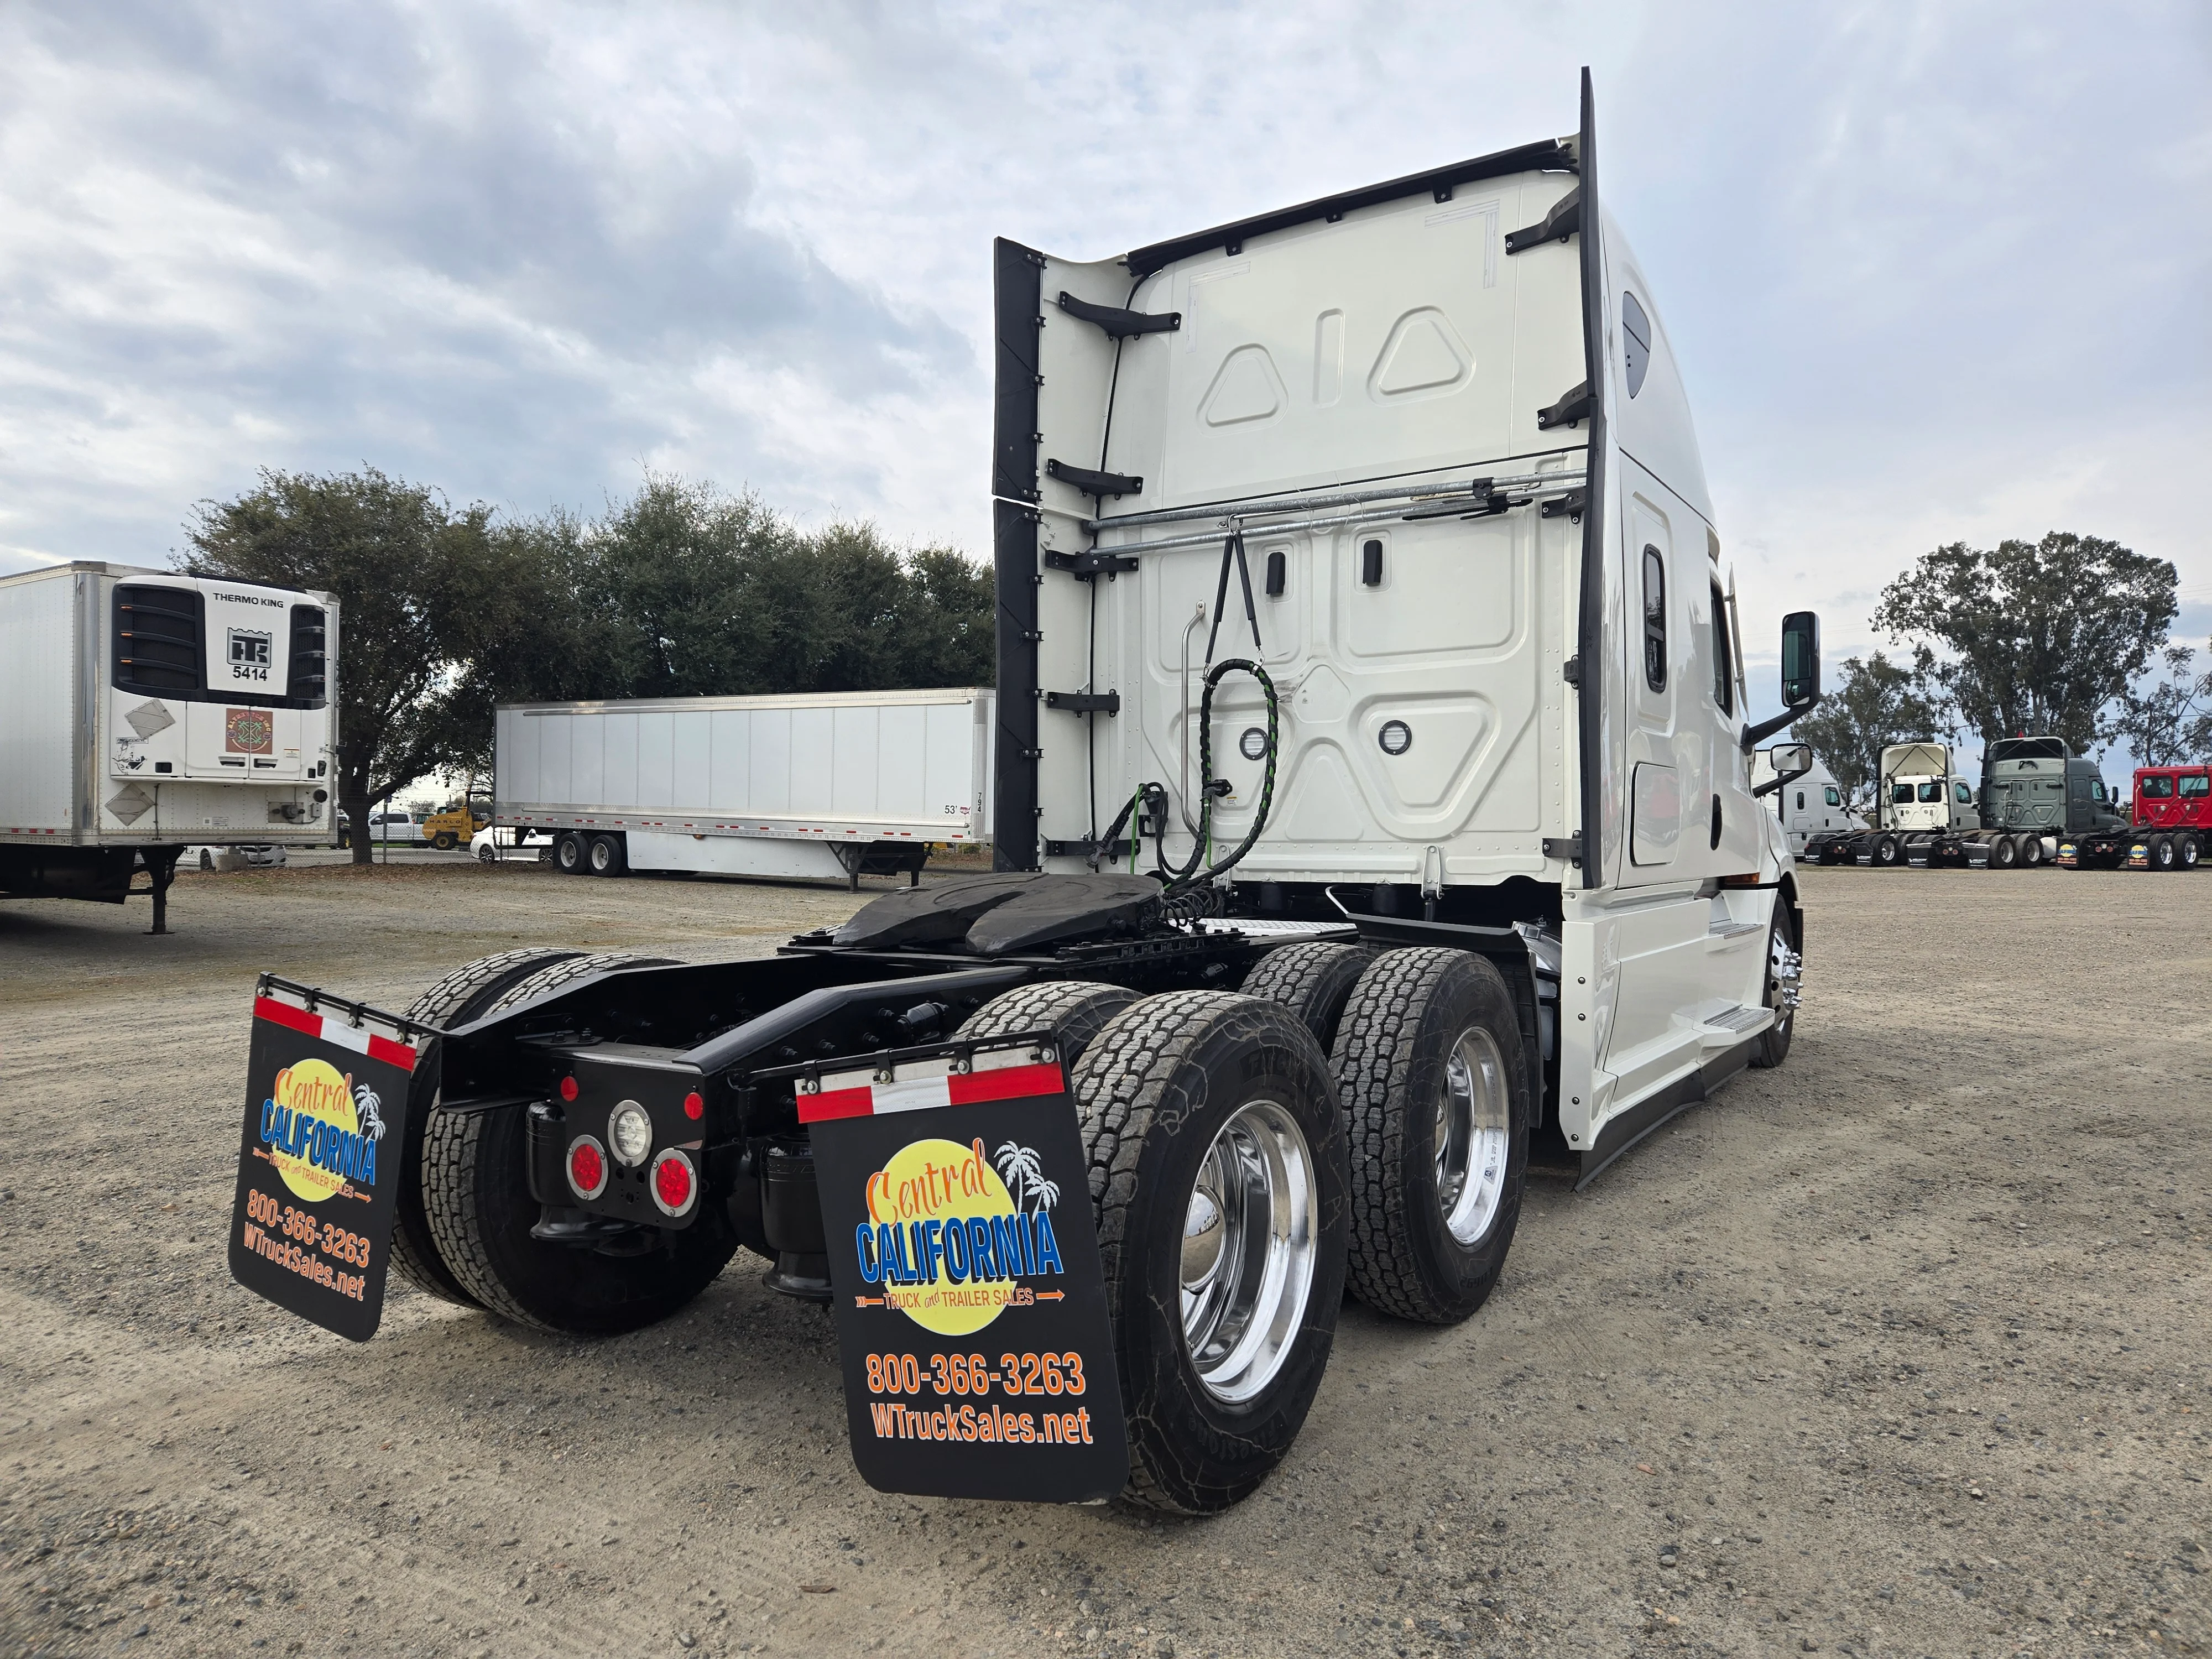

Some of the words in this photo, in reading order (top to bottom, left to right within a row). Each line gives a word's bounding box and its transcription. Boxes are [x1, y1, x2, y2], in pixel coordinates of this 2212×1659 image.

[212, 592, 259, 605] THERMO
[260, 598, 284, 608] KING
[232, 665, 268, 681] 5414
[945, 805, 957, 815] 53'
[274, 1068, 352, 1117] Central
[260, 1098, 377, 1186] CALIFORNIA
[269, 1152, 291, 1172] TRUCK
[291, 1164, 301, 1175] and
[302, 1167, 330, 1189] TRAILER
[331, 1179, 354, 1199] SALES
[866, 1137, 993, 1228] Central
[247, 1188, 370, 1268] 800-366-3263
[855, 1210, 1065, 1286] CALIFORNIA
[244, 1221, 366, 1302] WTruckSales.net
[883, 1292, 921, 1310] TRUCK
[924, 1287, 940, 1308] and
[941, 1290, 990, 1307] TRAILER
[993, 1287, 1035, 1306] SALES
[865, 1352, 1087, 1396] 800-366-3263
[869, 1402, 1094, 1445] WTruckSales.net
